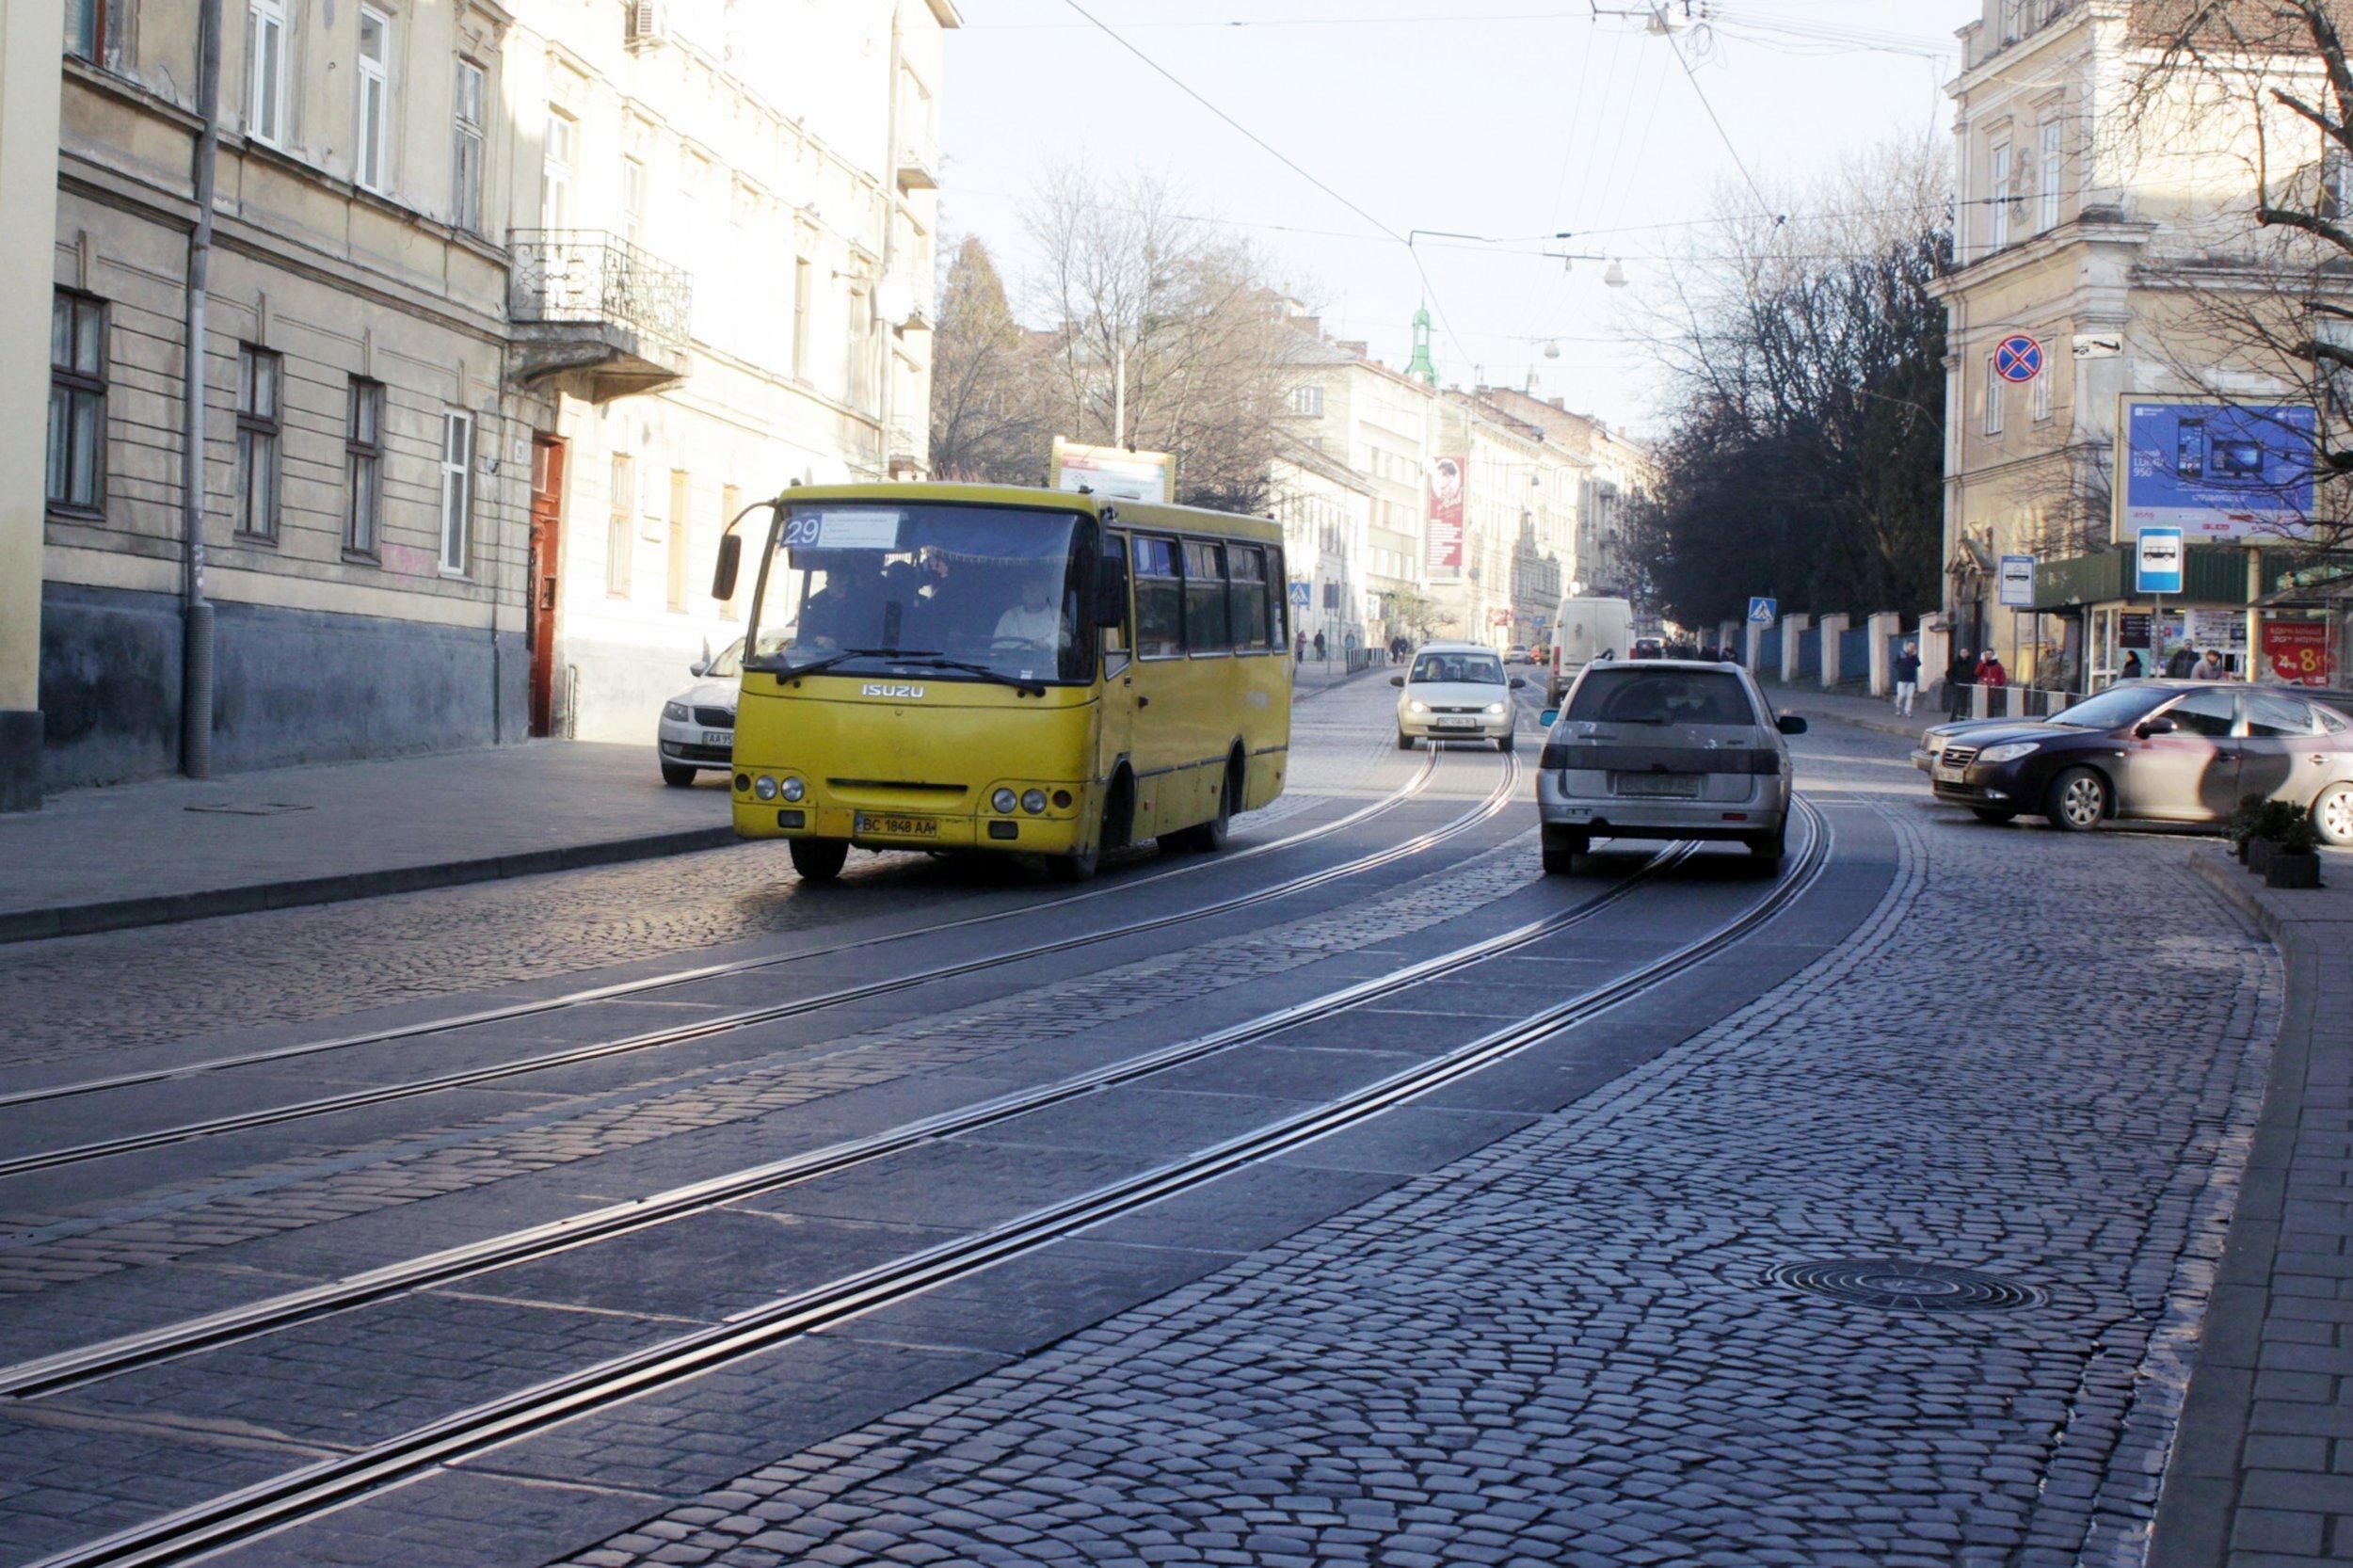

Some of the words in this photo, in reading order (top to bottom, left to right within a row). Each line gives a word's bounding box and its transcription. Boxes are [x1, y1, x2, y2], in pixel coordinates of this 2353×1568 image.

[783, 519, 820, 545] 29
[2299, 648, 2316, 672] 8
[861, 683, 924, 698] ISUZU
[863, 818, 881, 831] BC
[885, 819, 912, 832] 1848
